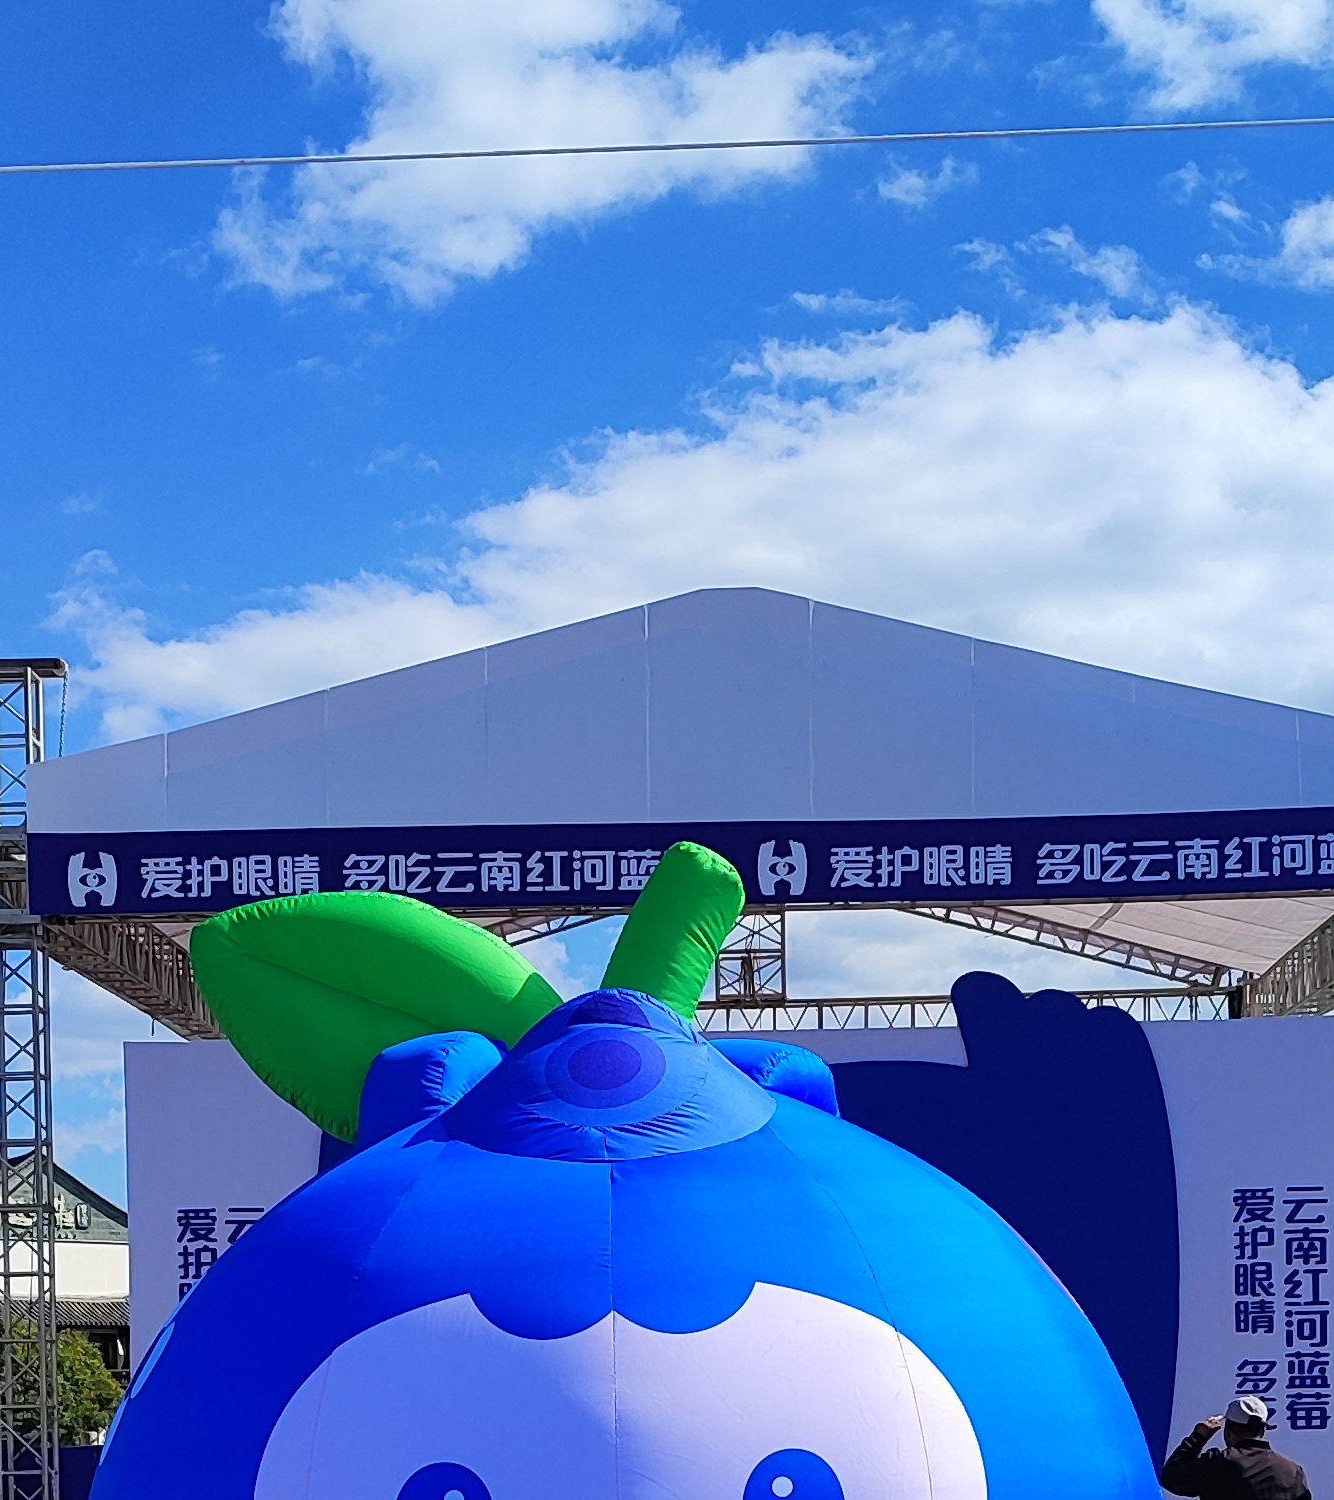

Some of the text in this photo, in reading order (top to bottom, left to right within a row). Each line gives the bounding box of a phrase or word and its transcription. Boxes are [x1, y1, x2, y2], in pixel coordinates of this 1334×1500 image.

[140, 850, 662, 898] 爱护眼睛 多吃云南红河蓝
[829, 844, 1013, 887] 爱护眼睛
[176, 1207, 218, 1303] 爱护
[1232, 1187, 1276, 1334] 爱护眼睛
[1282, 1186, 1332, 1430] 云南红河蓝莓
